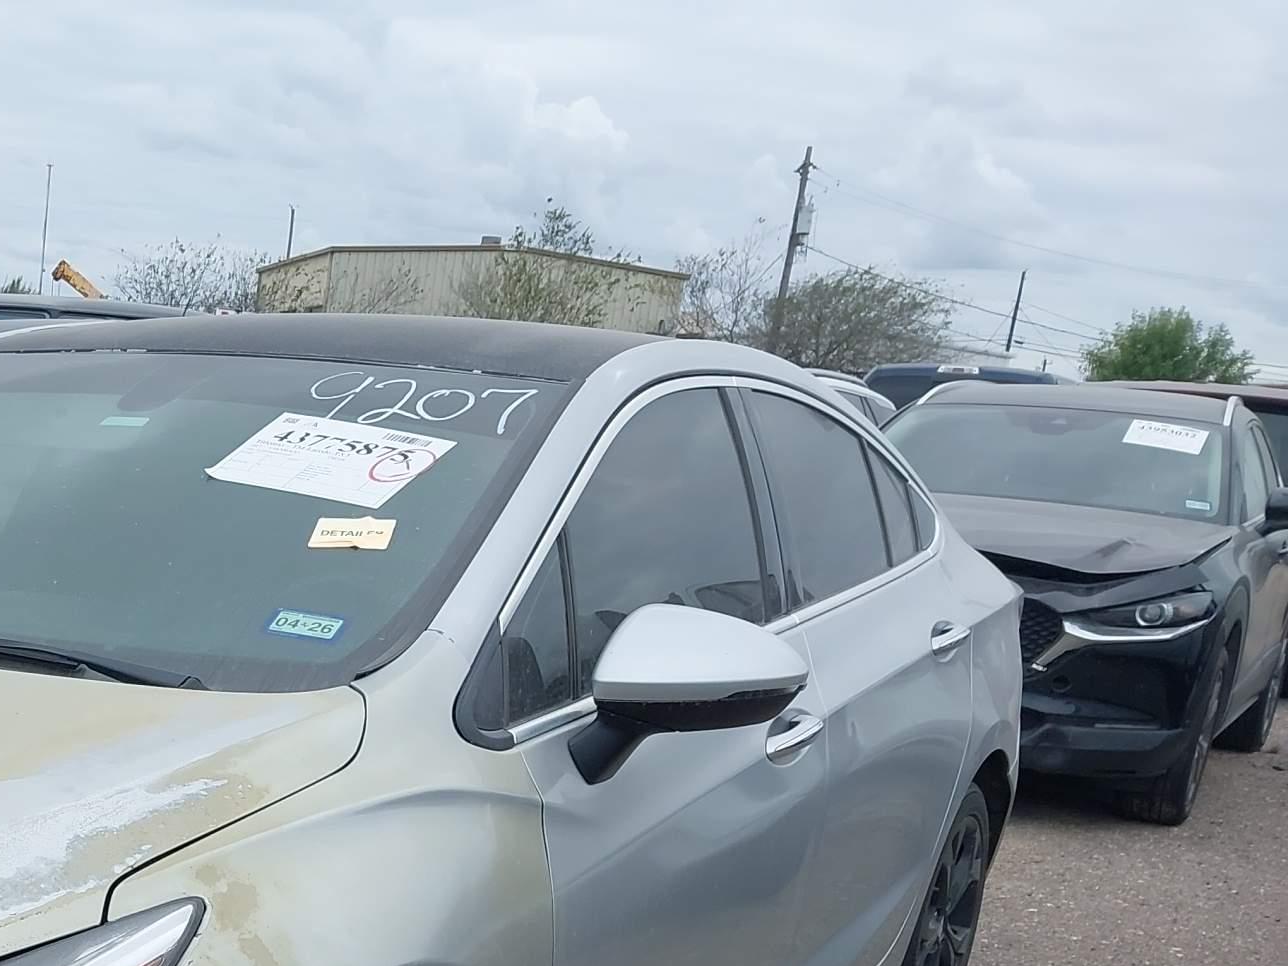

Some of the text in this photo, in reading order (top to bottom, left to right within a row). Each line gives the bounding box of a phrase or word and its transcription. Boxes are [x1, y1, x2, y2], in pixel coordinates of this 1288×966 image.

[310, 371, 539, 435] 9207
[273, 430, 416, 463] 43775875
[275, 617, 300, 629] 04
[306, 622, 334, 634] 26
